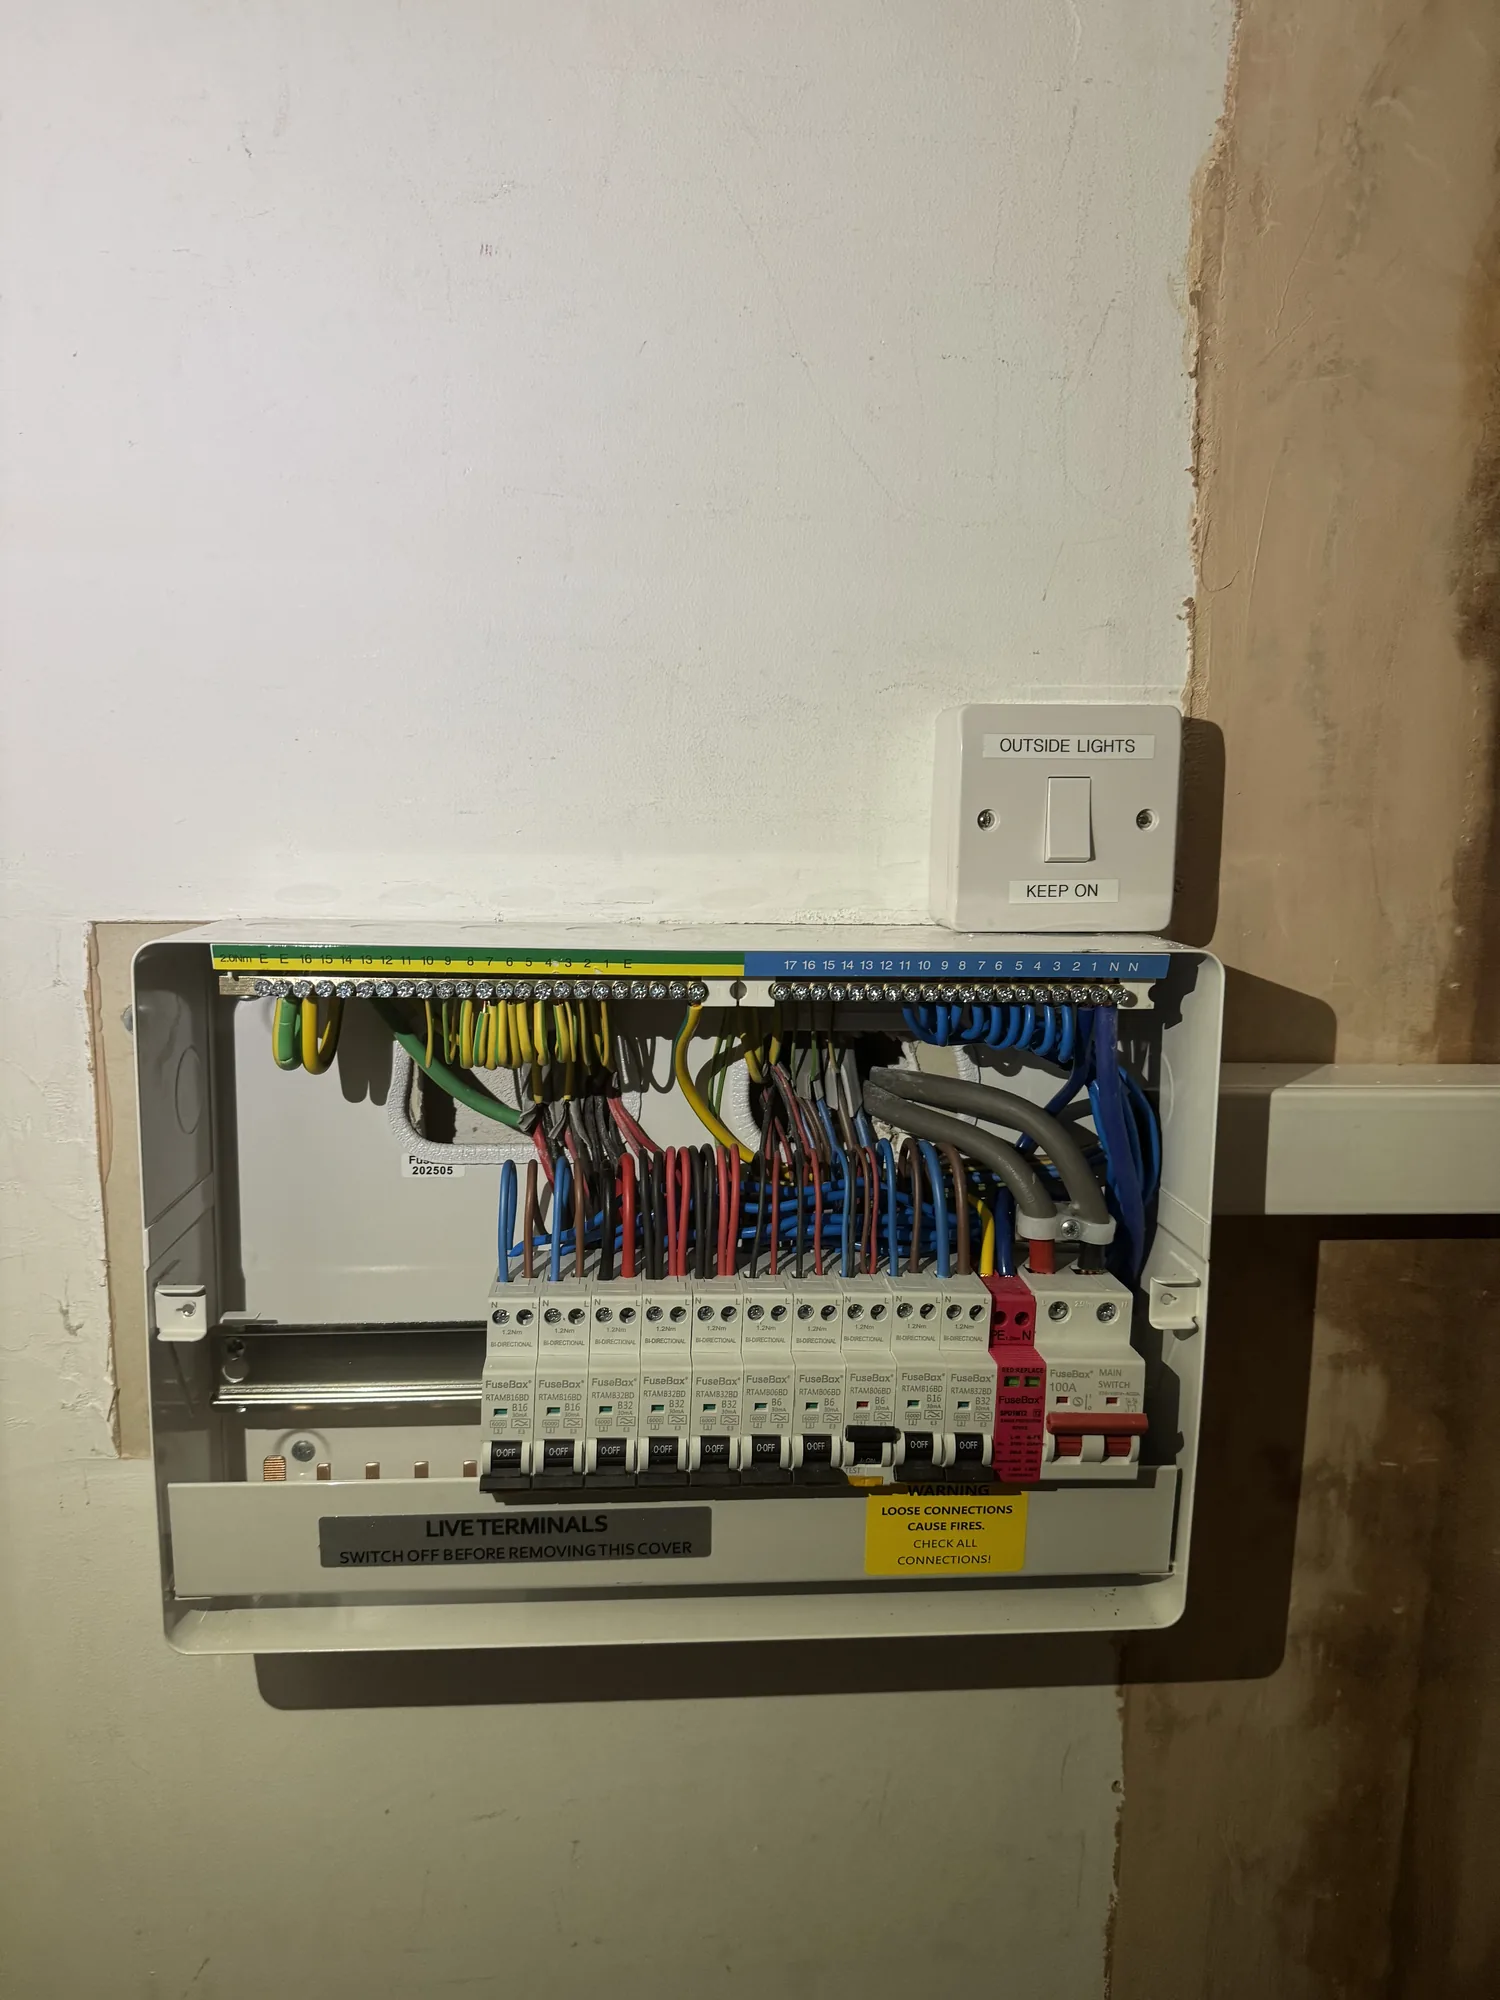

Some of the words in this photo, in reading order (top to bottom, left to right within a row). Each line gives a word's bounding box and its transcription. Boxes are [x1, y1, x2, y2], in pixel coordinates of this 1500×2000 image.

[1000, 738, 1070, 753] OUTSIDE
[1078, 739, 1136, 753] LIGHTS
[1027, 884, 1069, 898] KEEP
[1074, 883, 1098, 897] ON
[260, 955, 268, 963] E
[280, 955, 288, 964] E
[301, 955, 312, 964] 16
[320, 955, 333, 964] 15
[341, 955, 352, 964] 14
[361, 956, 373, 964] 13
[381, 956, 393, 964] 12
[401, 956, 411, 965] 11
[422, 956, 434, 965] 10
[444, 956, 451, 965] 9
[467, 957, 474, 966] 8
[487, 957, 493, 966] 7
[506, 957, 513, 966] 6
[526, 958, 532, 966] 5
[545, 958, 552, 967] 4
[565, 958, 572, 967] 3
[584, 959, 591, 967] 2
[604, 959, 609, 968] 1
[624, 959, 632, 968] E
[784, 961, 797, 970] 17
[803, 961, 815, 969] 16
[823, 961, 835, 969] 15
[842, 961, 854, 969] 14
[860, 961, 873, 970] 13
[880, 961, 893, 970] 12
[900, 961, 911, 970] 11
[918, 961, 931, 970] 10
[941, 961, 948, 970] 9
[959, 961, 966, 970] 8
[978, 961, 986, 970] 7
[995, 961, 1002, 970] 6
[1015, 961, 1023, 970] 5
[1034, 962, 1041, 970] 4
[1053, 962, 1061, 971] 3
[1072, 962, 1080, 971] 2
[1092, 962, 1097, 971] 1
[1110, 962, 1119, 971] N
[1128, 962, 1138, 971] N
[412, 1166, 453, 1174] 202505
[1022, 1331, 1032, 1340] N
[1050, 1383, 1077, 1392] 100A
[908, 1485, 989, 1496] WARNING
[882, 1507, 920, 1515] LOOSE
[924, 1506, 1013, 1515] CONNECTIONS
[426, 1520, 473, 1537] LIVE
[477, 1515, 608, 1535] TERMINALS
[908, 1522, 946, 1531] CAUSE
[951, 1522, 984, 1530] FIRES.
[913, 1540, 953, 1548] CHECK
[956, 1539, 977, 1547] ALL
[340, 1550, 403, 1564] SWITCH
[407, 1548, 439, 1563] OFF
[444, 1547, 505, 1561] BEFORE
[509, 1545, 596, 1559] REMOVING
[599, 1543, 635, 1556] THIS
[638, 1541, 692, 1555] COVER
[897, 1555, 991, 1565] CONNECTIONS!
